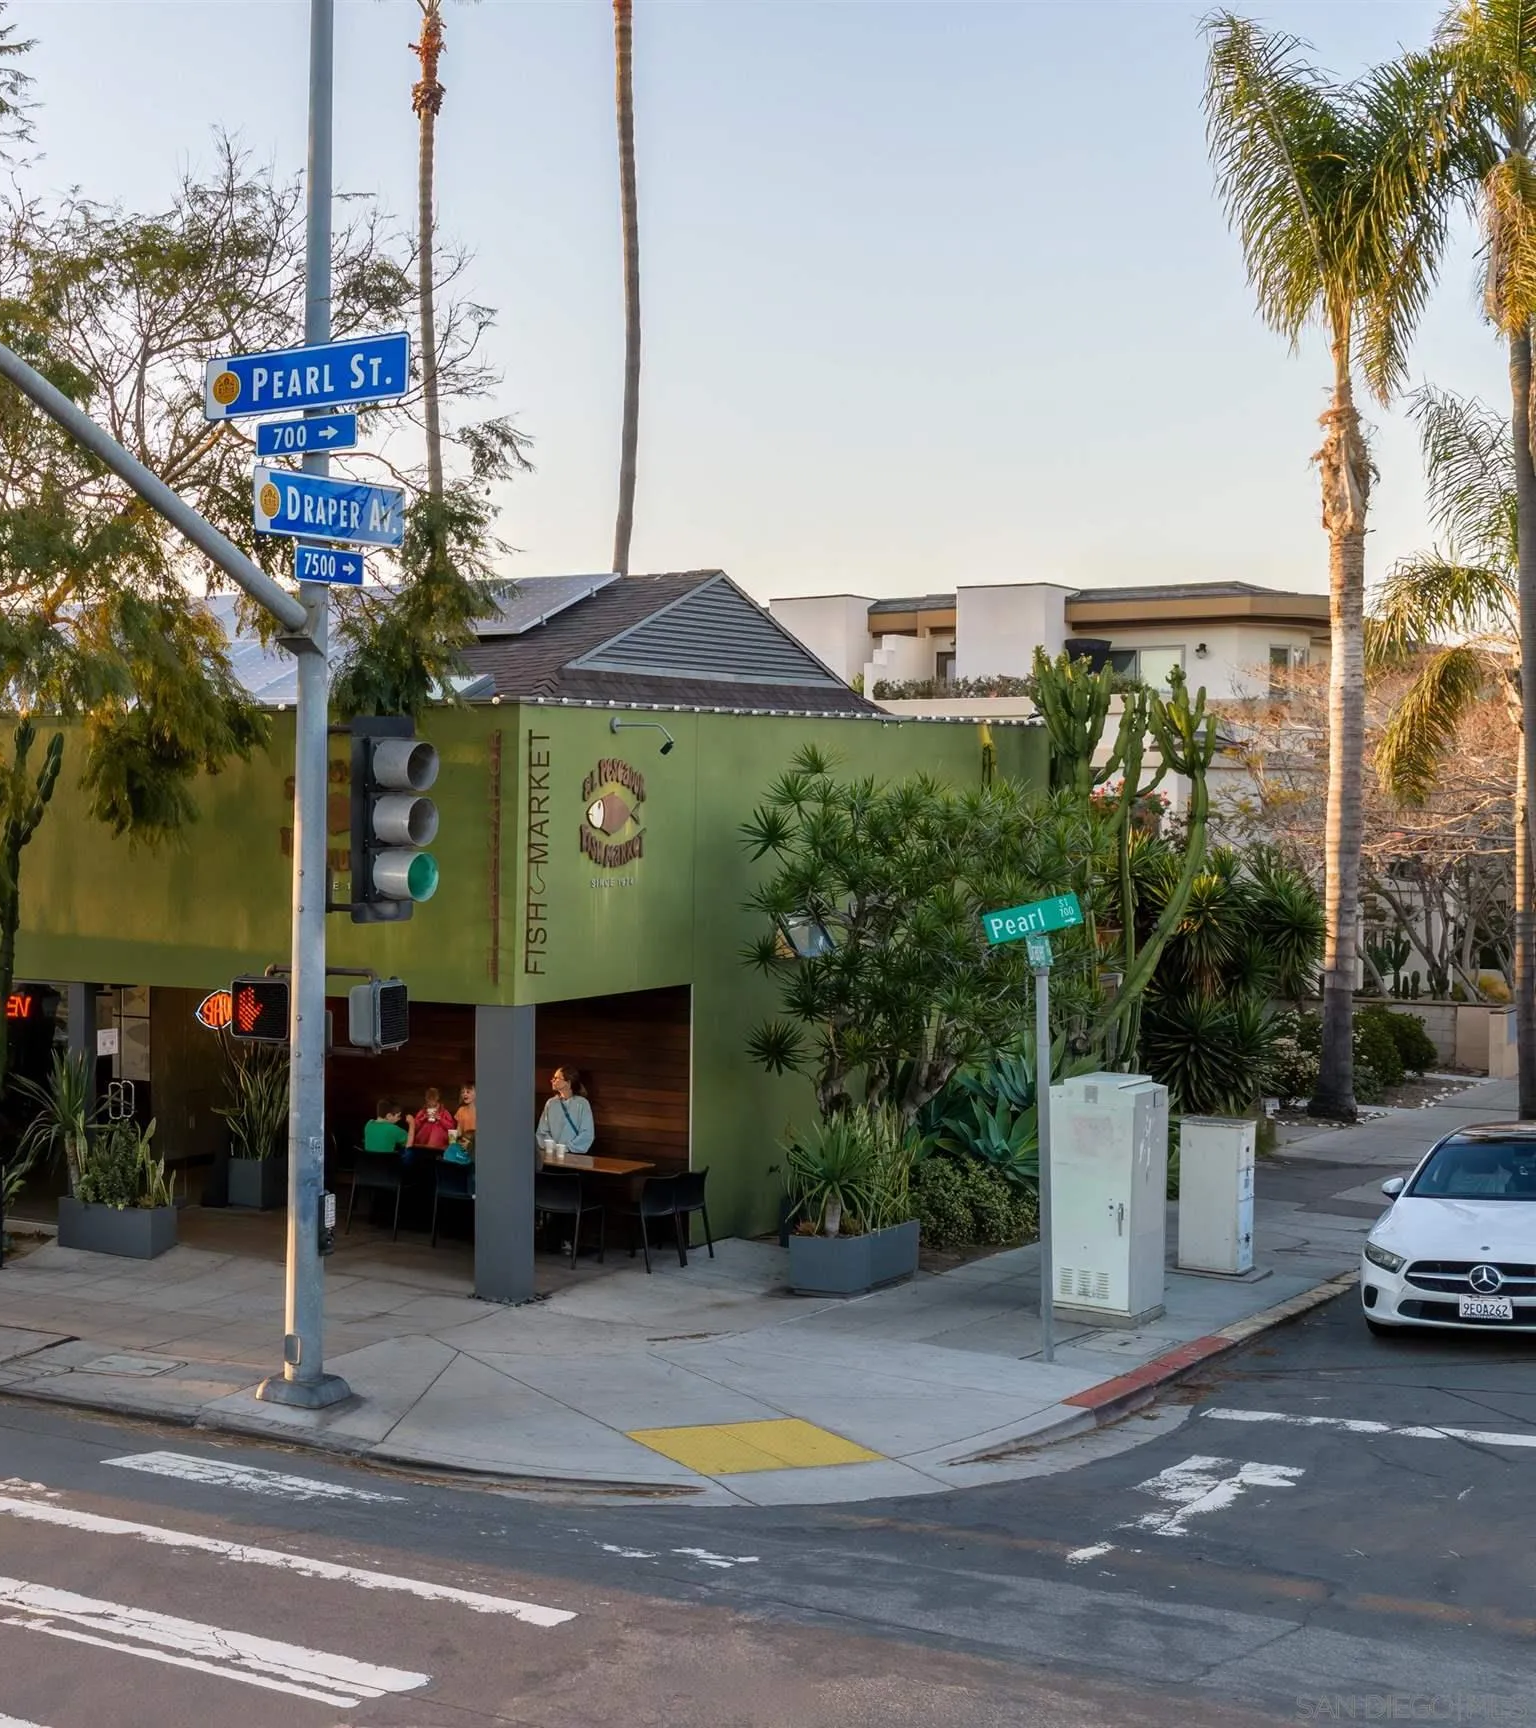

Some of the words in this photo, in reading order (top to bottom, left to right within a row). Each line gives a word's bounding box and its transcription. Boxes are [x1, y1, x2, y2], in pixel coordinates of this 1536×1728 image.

[252, 364, 335, 402] PEARL
[350, 353, 392, 390] ST.
[273, 425, 307, 450] 700
[287, 486, 361, 530] DRAPER
[304, 552, 337, 578] 7500
[527, 729, 551, 865] MARKET
[990, 907, 1046, 939] Pearl
[1059, 906, 1074, 918] 700
[525, 901, 548, 975] FISH
